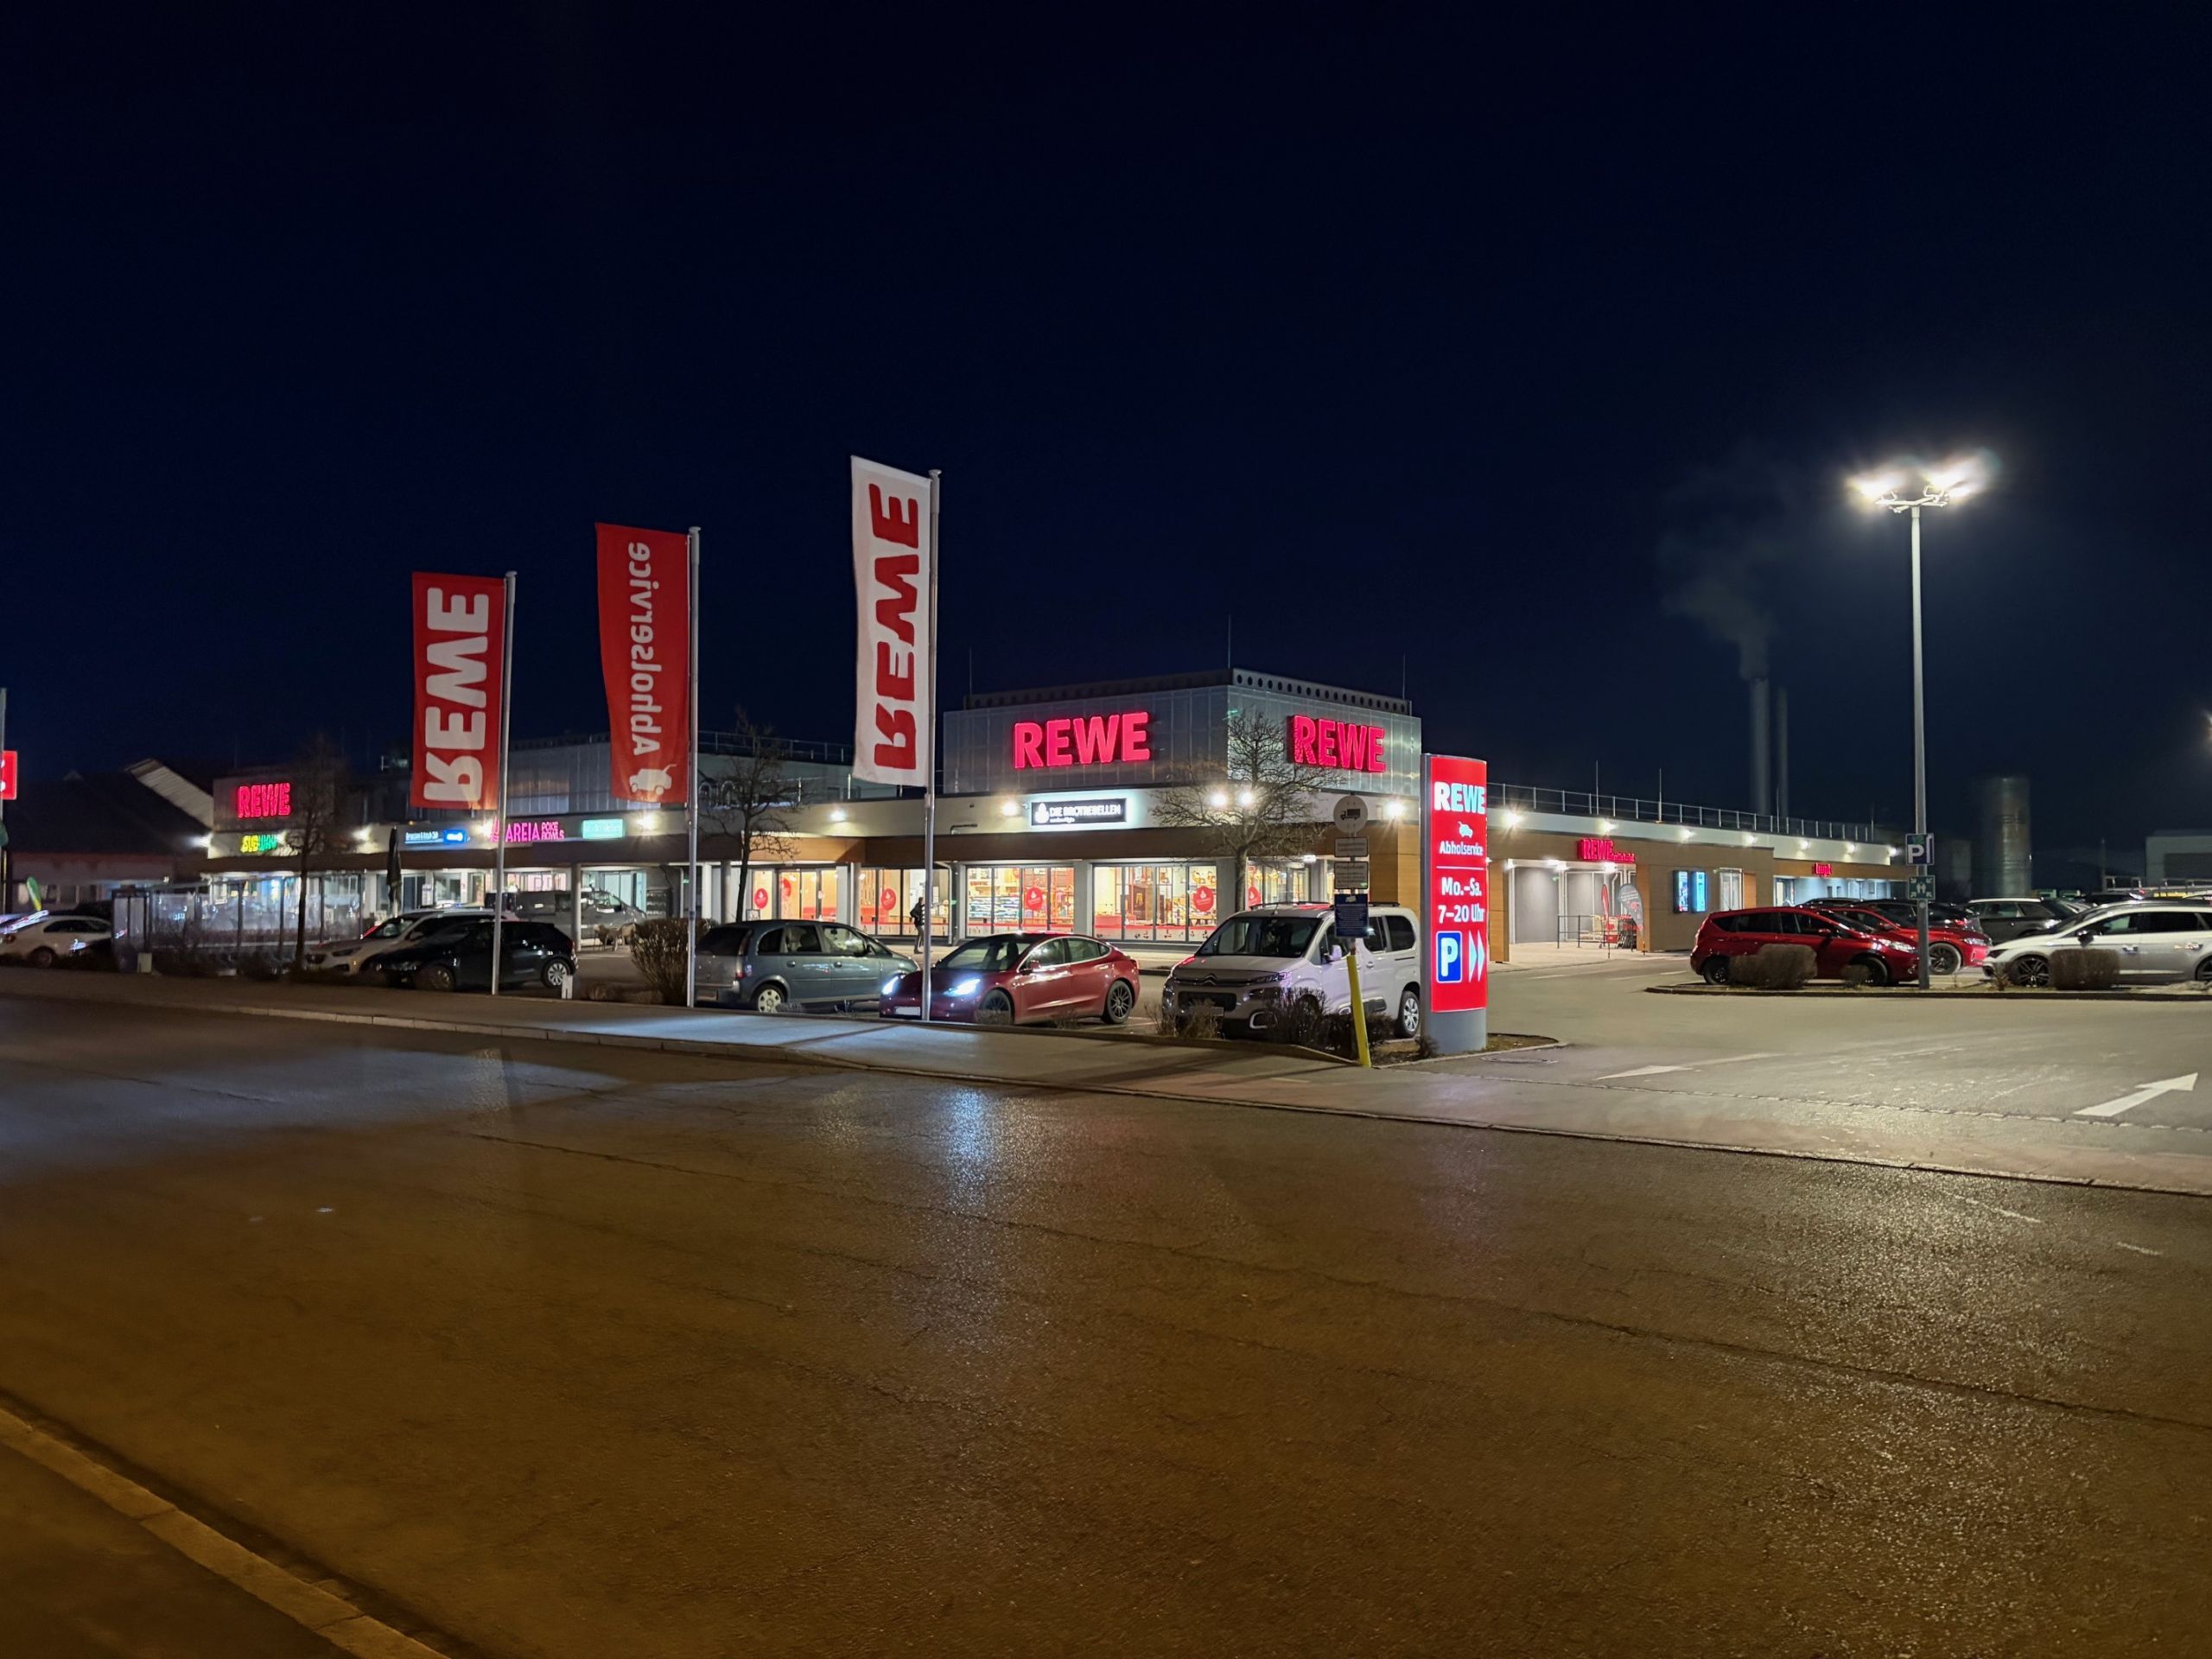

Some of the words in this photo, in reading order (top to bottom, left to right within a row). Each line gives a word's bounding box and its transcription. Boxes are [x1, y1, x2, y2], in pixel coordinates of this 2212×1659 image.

[1014, 712, 1151, 769] REWE
[1293, 715, 1388, 775] REWE
[238, 783, 290, 818] REWE
[1433, 781, 1486, 814] REWE
[505, 823, 540, 842] AREIA
[1439, 840, 1484, 856] Abholservice
[1582, 839, 1614, 861] REWE
[1907, 844, 1924, 864] P
[1471, 903, 1485, 923] Uhr
[1440, 937, 1459, 978] P
